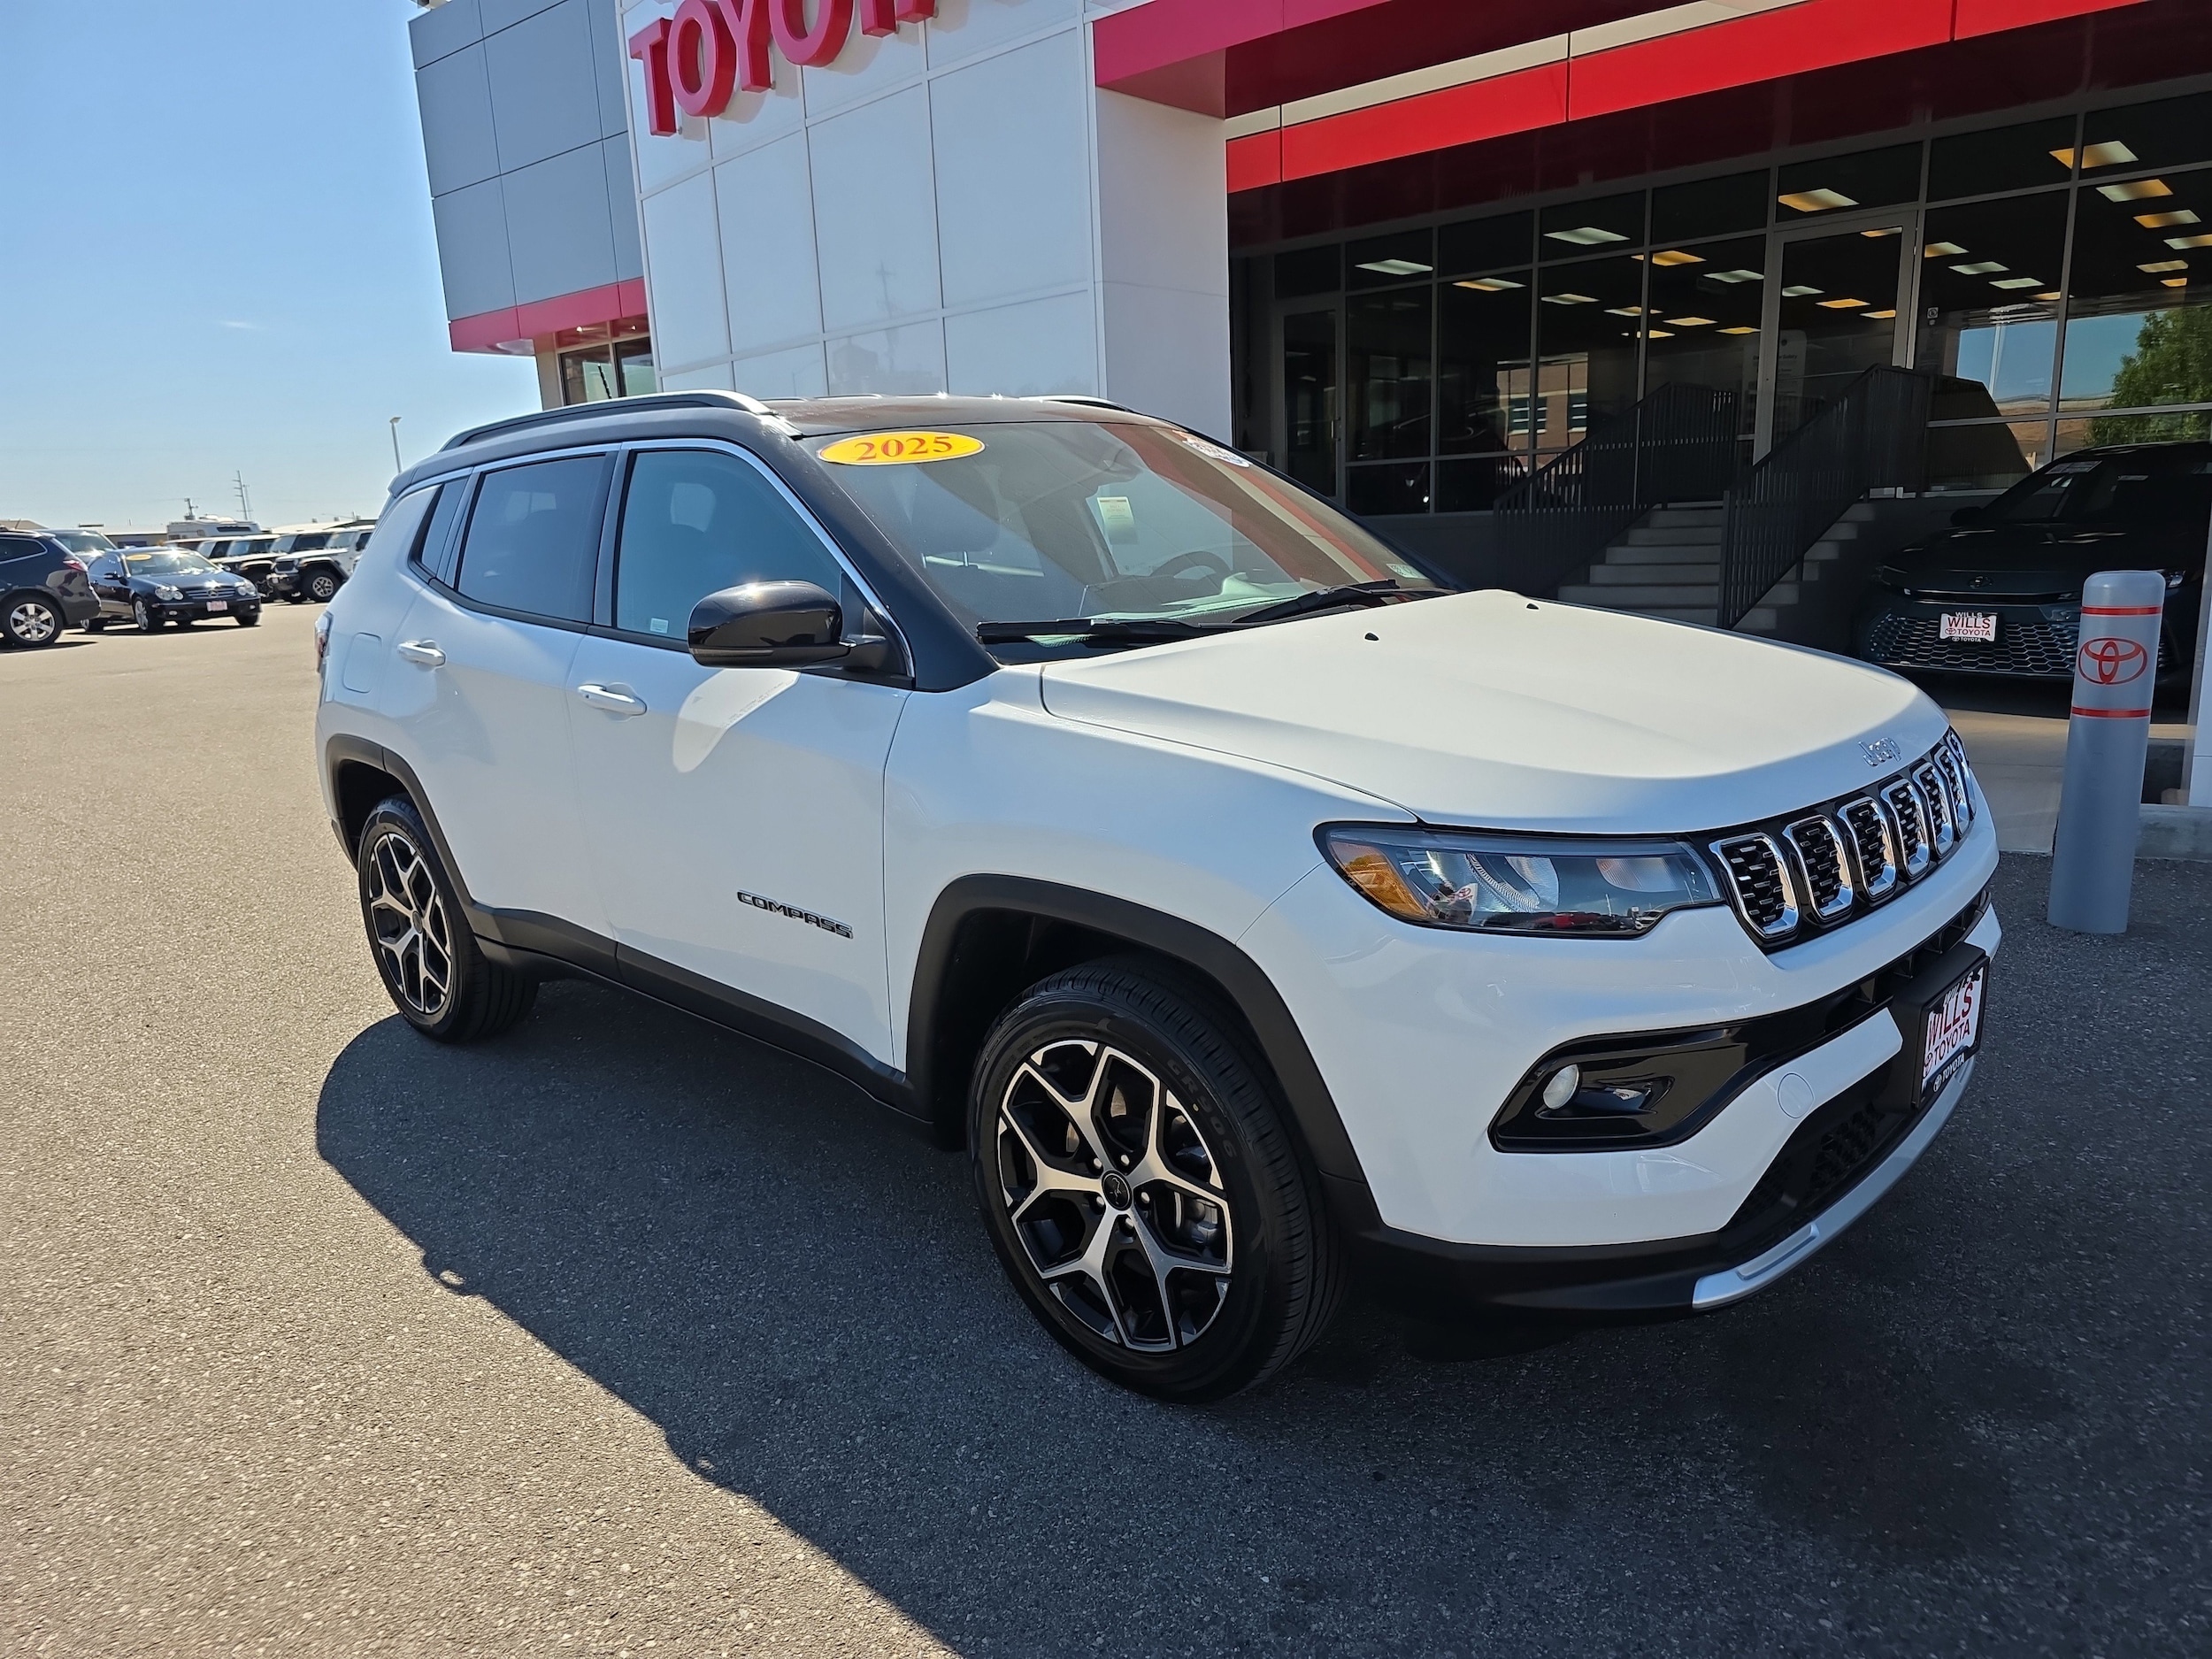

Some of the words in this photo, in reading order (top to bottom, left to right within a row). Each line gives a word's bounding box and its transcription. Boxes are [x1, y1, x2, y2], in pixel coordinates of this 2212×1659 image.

[629, 0, 936, 137] TOYO
[854, 436, 953, 461] 2025
[1947, 617, 1991, 629] WILLS
[1858, 737, 1901, 767] Jeep
[737, 889, 854, 940] COMPASS
[1927, 983, 1973, 1051] WILLS
[1933, 1018, 1970, 1065] TOYOTA
[1942, 1052, 1965, 1083] TOYOTA
